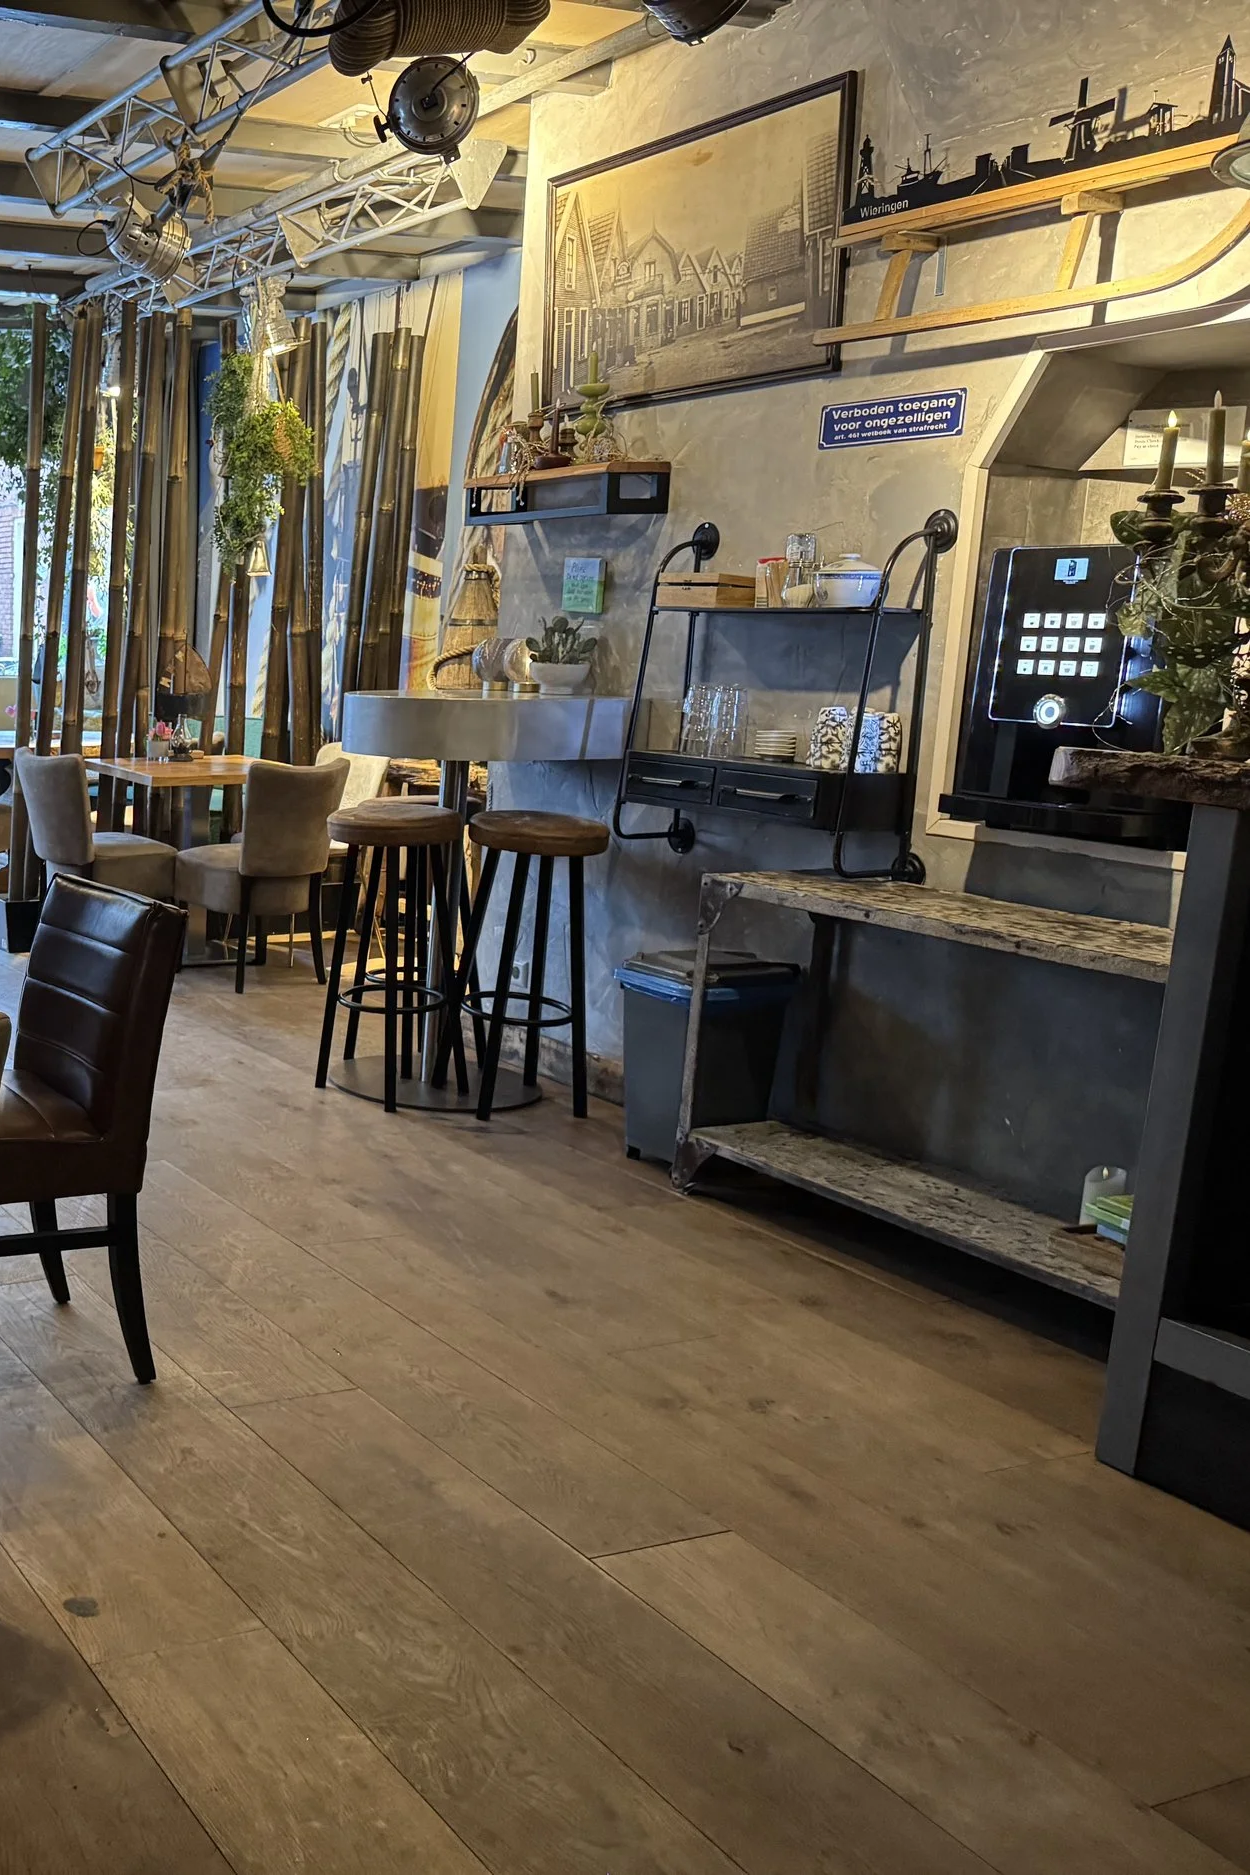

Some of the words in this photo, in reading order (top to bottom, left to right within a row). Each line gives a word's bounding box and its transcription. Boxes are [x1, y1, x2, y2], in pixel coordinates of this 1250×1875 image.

[860, 200, 908, 218] Wieringen
[832, 404, 894, 420] Verboden
[897, 397, 956, 412] toegang
[833, 421, 861, 432] voor
[864, 411, 951, 428] ongezelligen
[861, 427, 892, 437] wetboek
[908, 423, 948, 433] strafrecht
